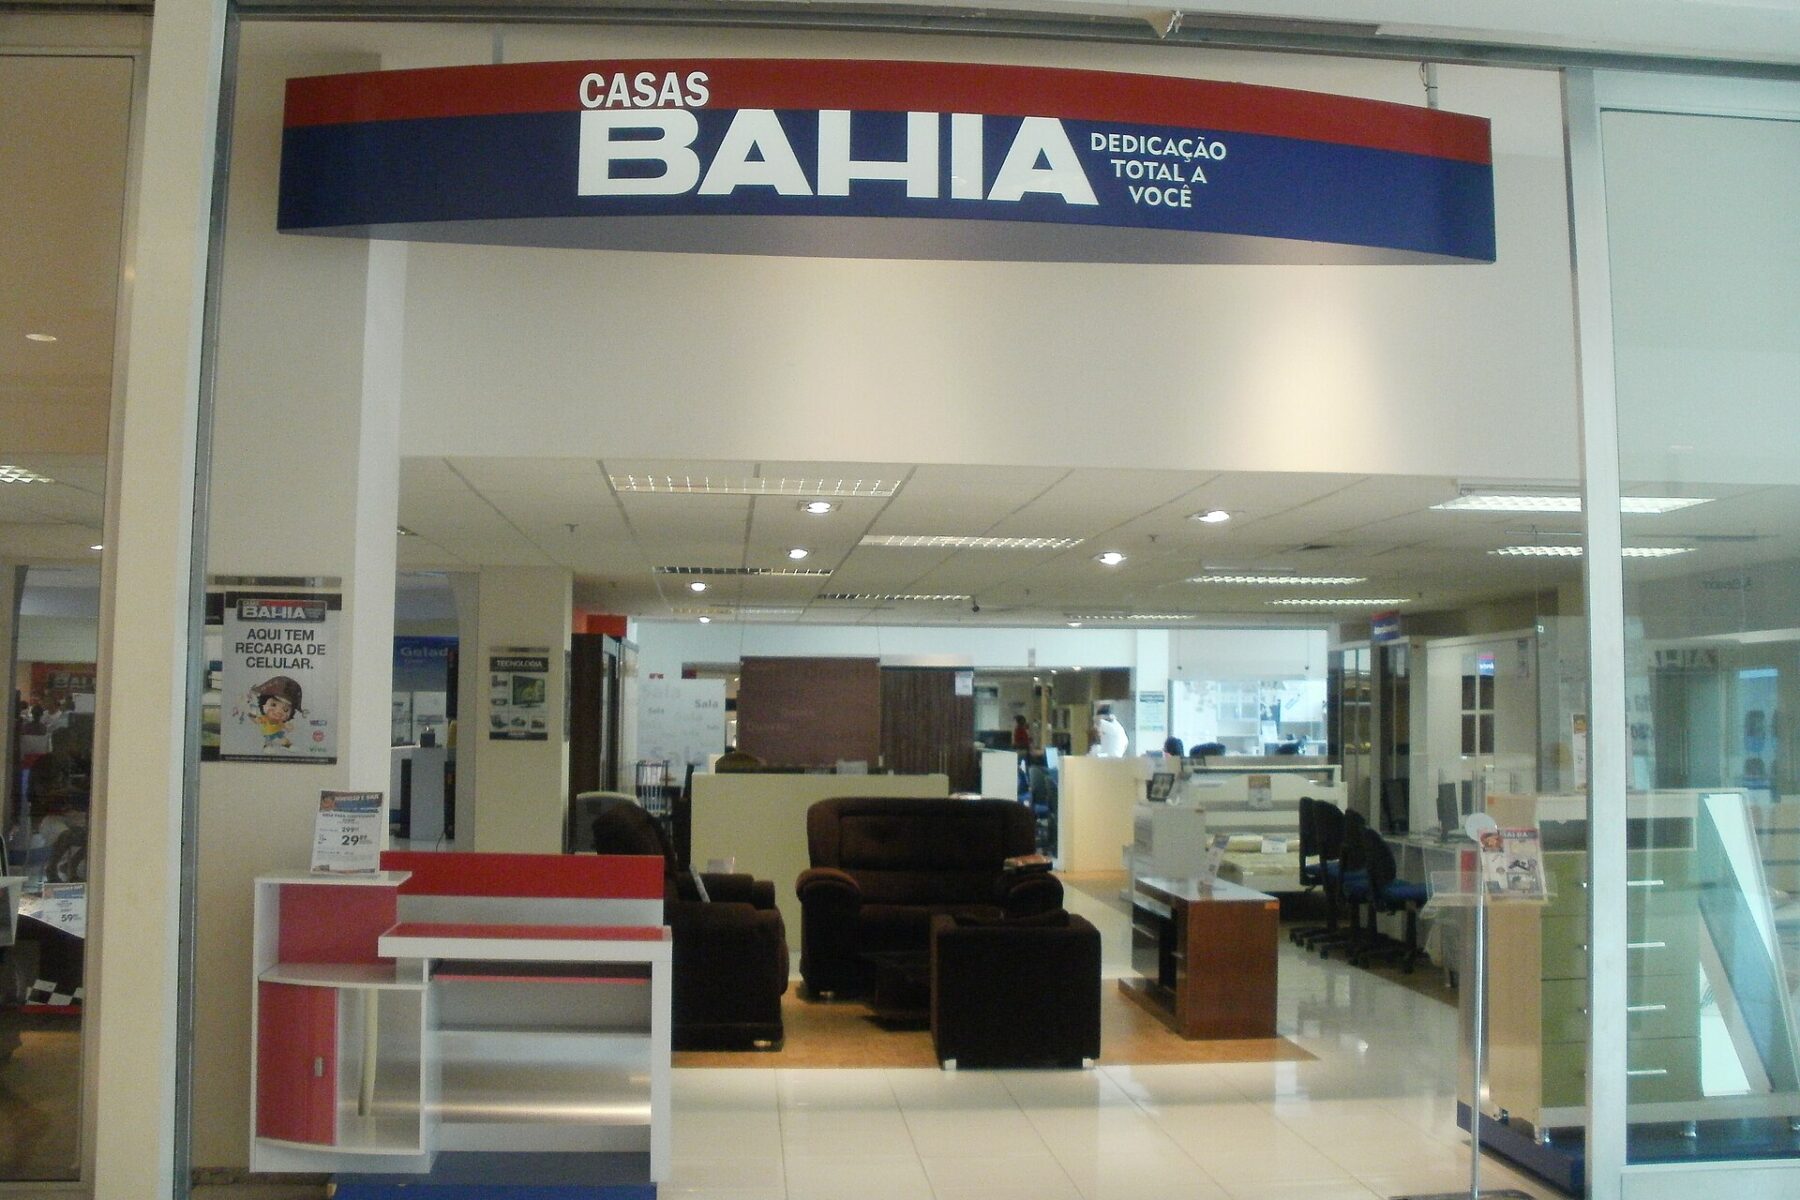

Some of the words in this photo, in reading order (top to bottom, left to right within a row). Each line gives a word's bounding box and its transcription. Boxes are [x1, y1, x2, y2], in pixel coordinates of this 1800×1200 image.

[578, 71, 709, 109] CASAS
[577, 108, 1099, 205] BAHIA
[1090, 132, 1227, 163] DEDICAÇÃO
[1110, 159, 1185, 182] TOTAL
[1191, 166, 1208, 184] A
[1128, 184, 1192, 208] VOCÊ
[242, 606, 306, 619] BAHIA
[247, 628, 281, 640] AQUI
[284, 629, 315, 641] TEM
[235, 642, 303, 655] RECARGA
[306, 644, 326, 656] DE
[246, 656, 314, 670] CELULAR.
[694, 700, 719, 709] Sala
